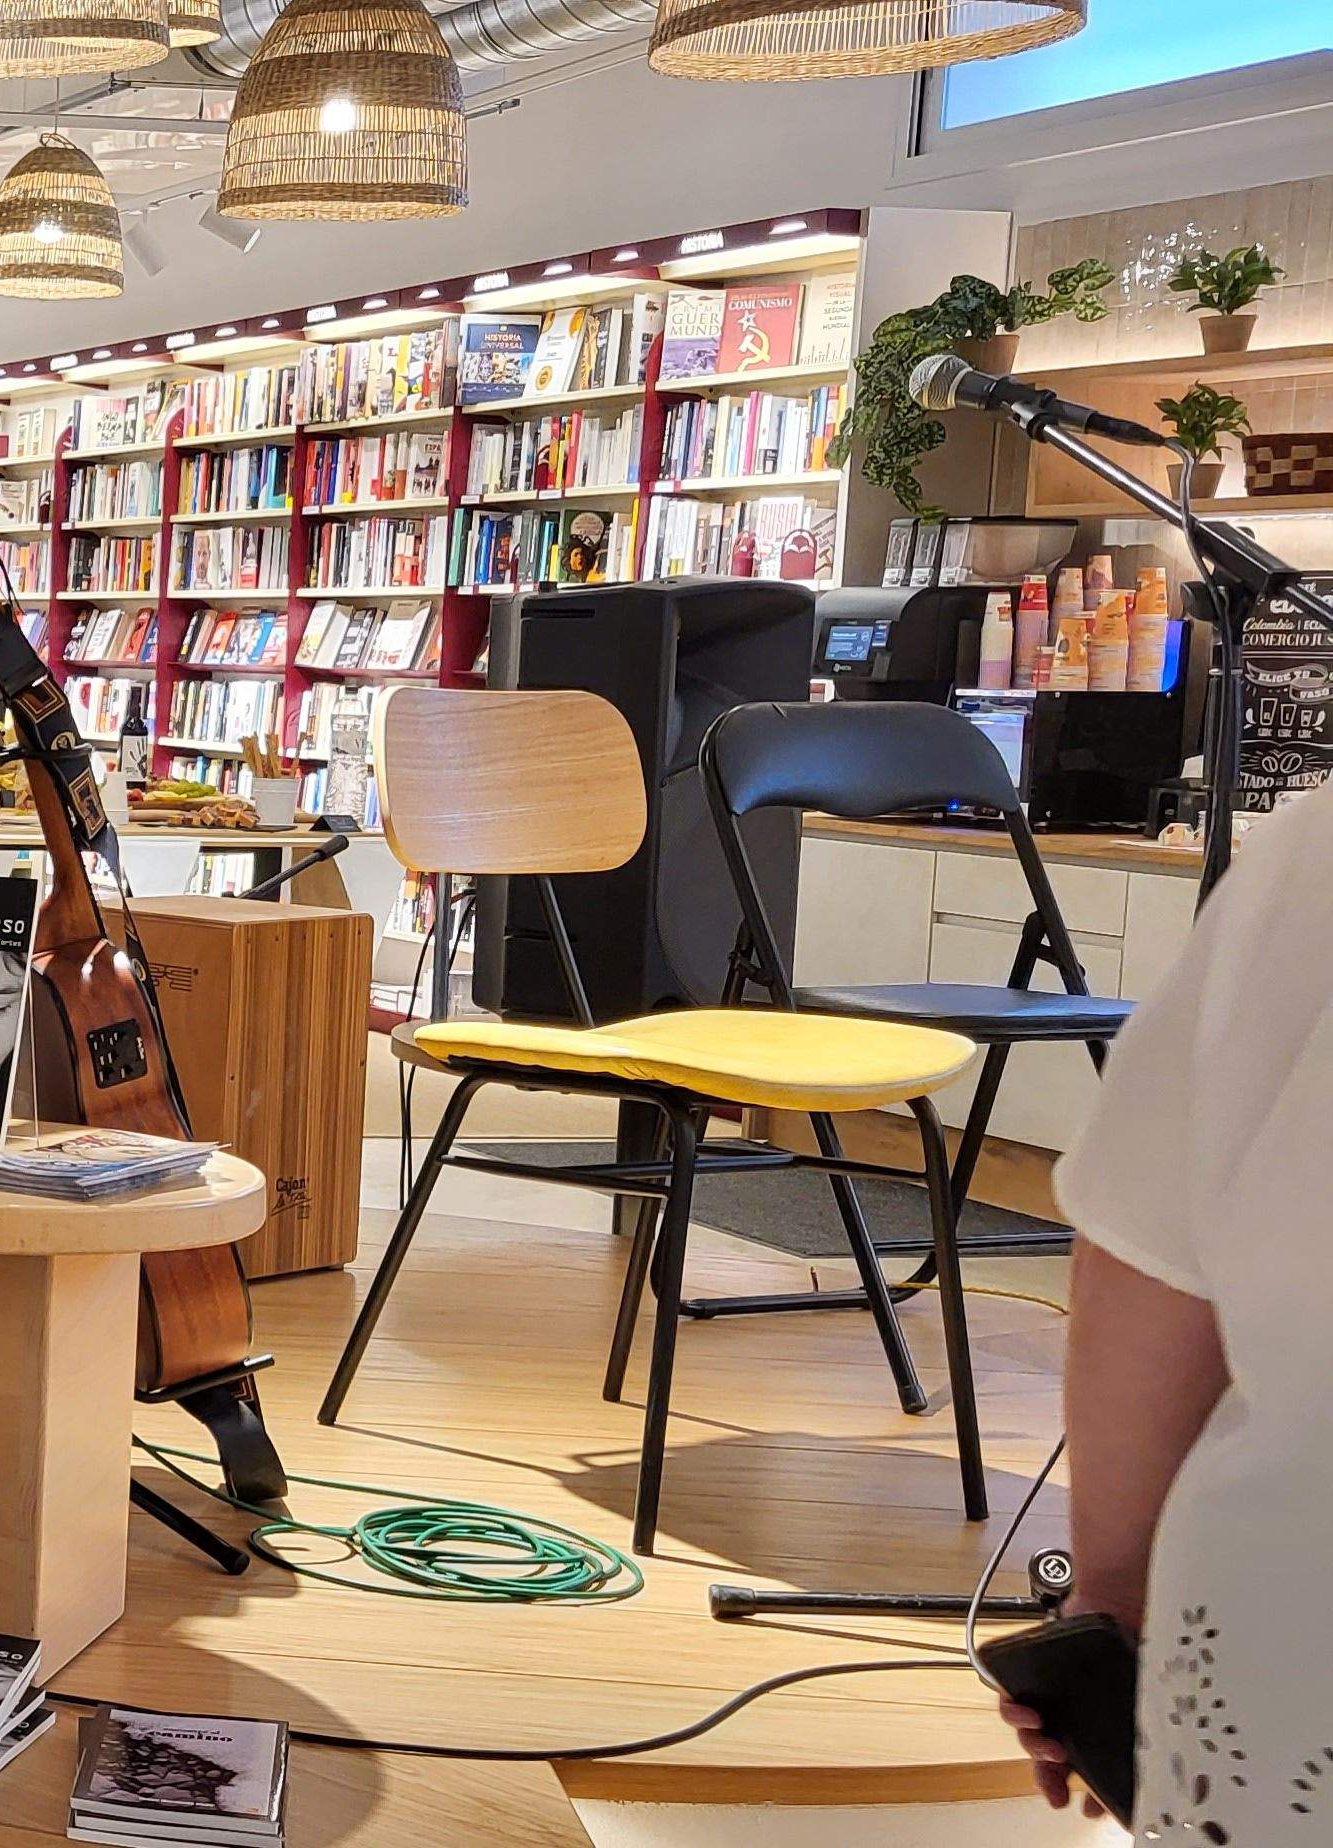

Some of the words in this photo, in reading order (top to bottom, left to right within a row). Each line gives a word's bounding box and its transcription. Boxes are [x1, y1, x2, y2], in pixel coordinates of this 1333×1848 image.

[728, 297, 793, 311] COMUNISMO
[671, 311, 720, 325] GUER
[669, 324, 721, 337] MUND
[1242, 616, 1295, 632] Colombia
[1242, 633, 1310, 647] COMERCIO
[1258, 672, 1292, 683] ELIGE
[1299, 687, 1330, 699] VASO
[1045, 1558, 1065, 1577] LP
